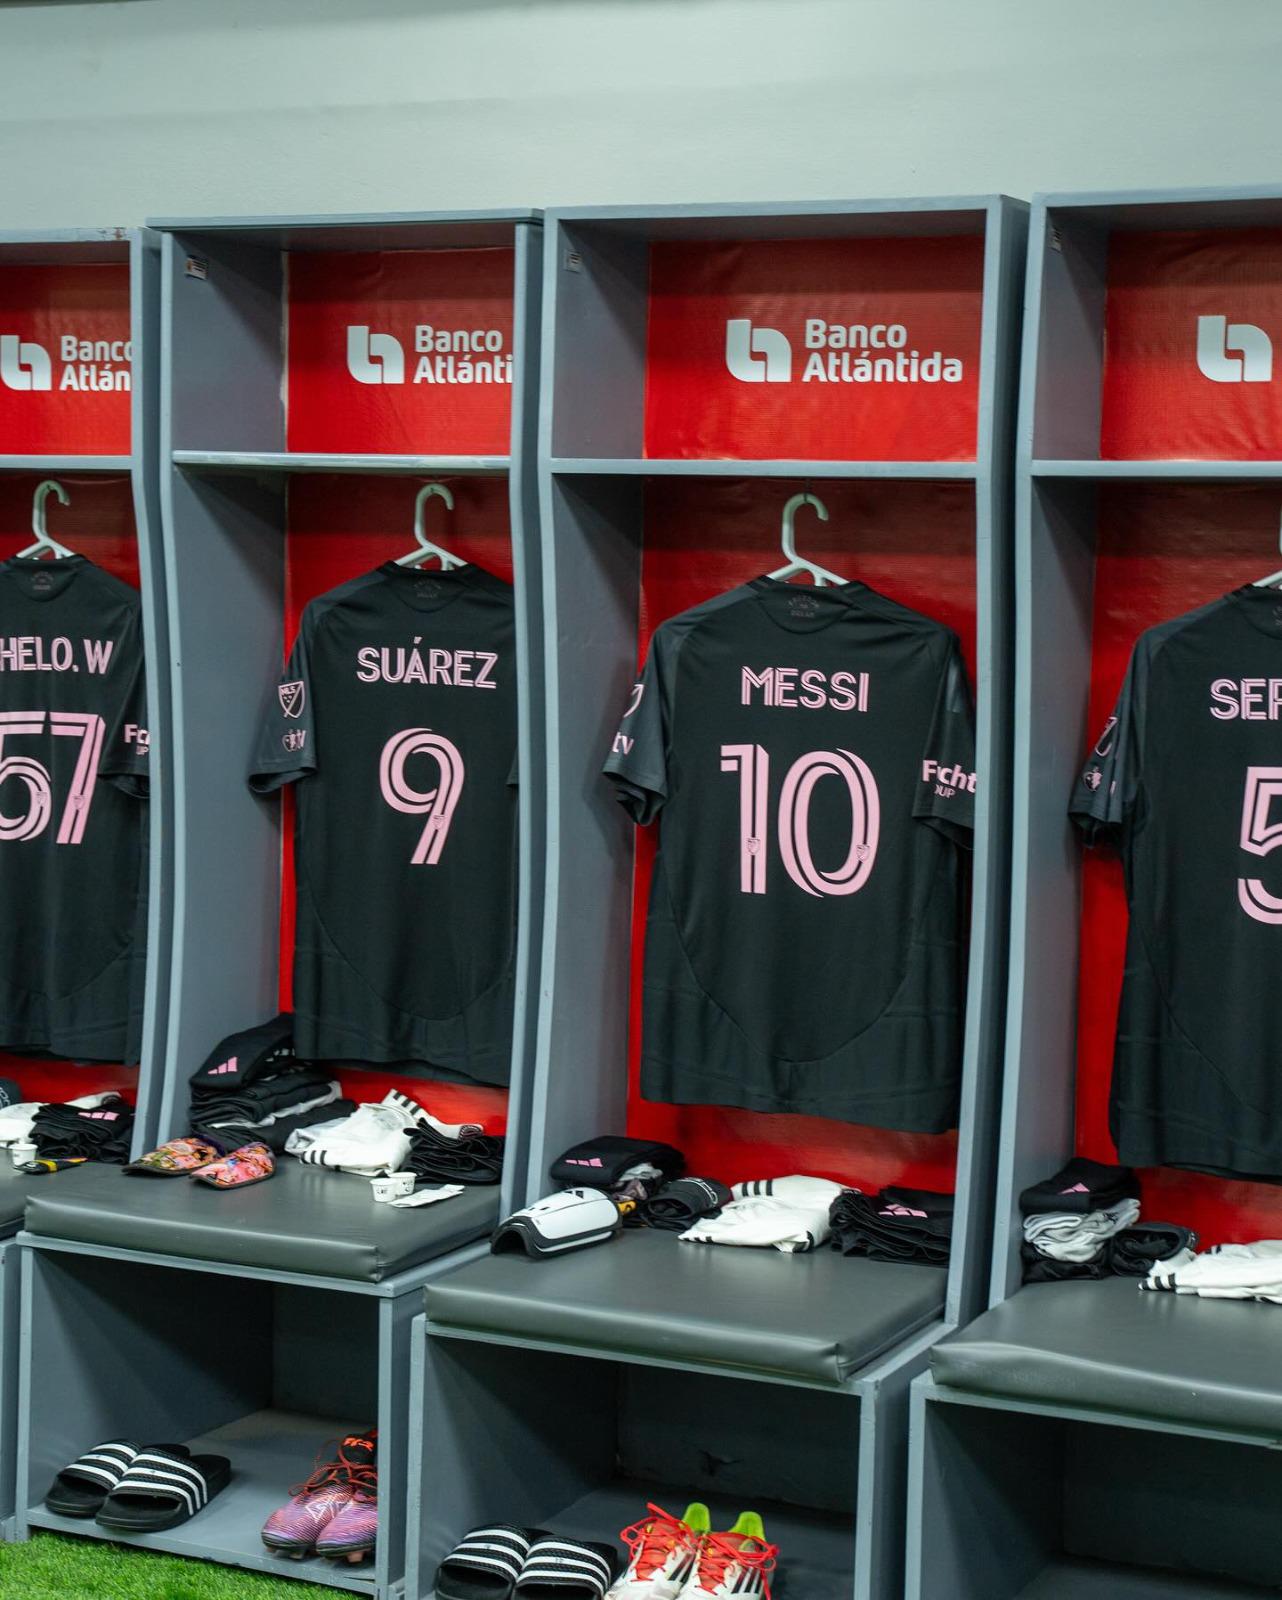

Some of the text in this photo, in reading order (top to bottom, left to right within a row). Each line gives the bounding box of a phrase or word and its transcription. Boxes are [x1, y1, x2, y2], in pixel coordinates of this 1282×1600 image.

[415, 325, 503, 353] Banco
[805, 318, 907, 349] Banco
[59, 363, 132, 391] Atlán
[413, 354, 513, 384] Atlánti
[802, 351, 964, 383] Atlántida
[356, 636, 499, 690] SUÁREZ
[741, 665, 870, 713] MESSI
[379, 727, 465, 865] 9
[720, 743, 881, 898] 10
